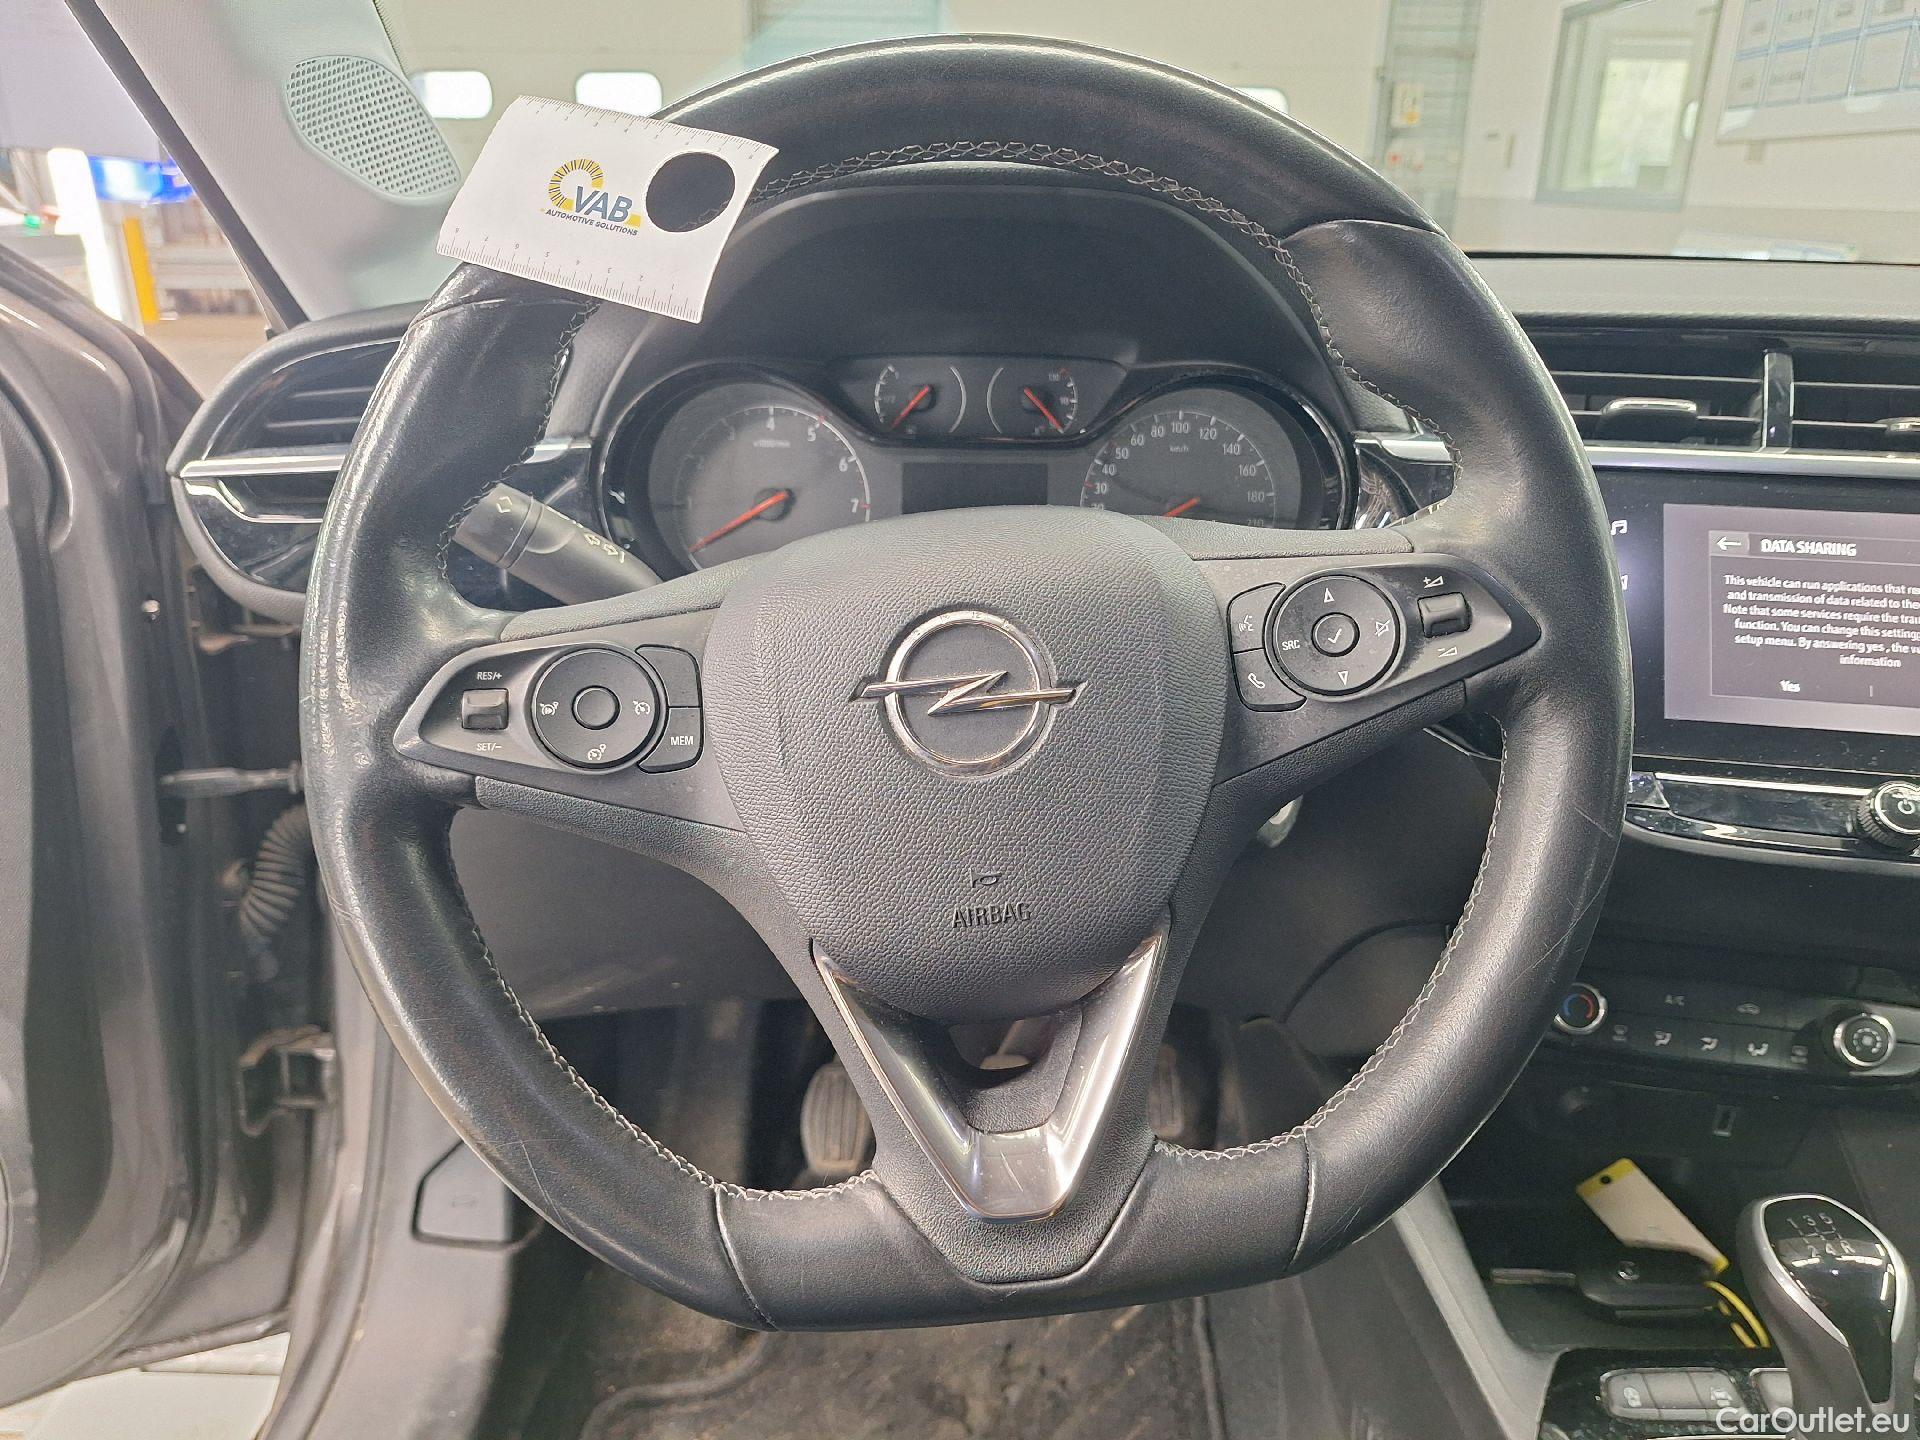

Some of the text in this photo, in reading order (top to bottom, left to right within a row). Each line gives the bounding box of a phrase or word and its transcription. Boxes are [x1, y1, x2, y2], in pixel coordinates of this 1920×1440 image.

[575, 186, 633, 223] VAB
[545, 209, 639, 237] AUTOMOTIVE SOLUTIONS
[807, 426, 817, 442] 5
[1150, 425, 1164, 438] 80
[1171, 422, 1189, 434] 100
[1199, 428, 1217, 441] 120
[1130, 434, 1145, 446] 60
[1115, 447, 1129, 460] 50
[1222, 443, 1241, 456] 140
[838, 456, 849, 472] 6
[1101, 462, 1117, 476] 40
[1238, 463, 1257, 477] 160
[1094, 482, 1108, 495] 30
[1247, 490, 1265, 503] 180
[850, 497, 859, 514] 7
[1760, 538, 1857, 557] DATA SHARING
[1723, 574, 1745, 586] This
[1746, 575, 1782, 588] vehicle
[1783, 579, 1801, 589] can
[1802, 581, 1820, 590] run
[1821, 580, 1883, 593] applications
[1884, 583, 1906, 594] that
[1727, 590, 1747, 600] and
[1748, 592, 1812, 604] transmission
[1813, 593, 1826, 605] of
[1826, 594, 1850, 606] data
[1851, 596, 1887, 608] related
[1888, 599, 1900, 609] to
[1722, 603, 1748, 615] Note
[1749, 604, 1770, 616] that
[1771, 607, 1800, 617] some
[1800, 609, 1842, 620] services
[1843, 611, 1880, 624] require
[1881, 612, 1900, 623] the
[1734, 617, 1780, 631] function.
[1780, 621, 1800, 632] You
[1801, 624, 1820, 633] can
[1821, 624, 1859, 638] change
[1860, 625, 1880, 637] this
[1282, 639, 1300, 651] SRC
[1734, 634, 1764, 647] setup
[1764, 637, 1797, 647] menu.
[1798, 636, 1812, 650] By
[1812, 638, 1866, 653] answering
[1892, 641, 1910, 653] the
[1840, 653, 1902, 668] information
[476, 671, 503, 681] RES/+
[1780, 680, 1801, 693] Yes
[670, 734, 694, 746] MEM
[952, 901, 1032, 929] AIRBAG
